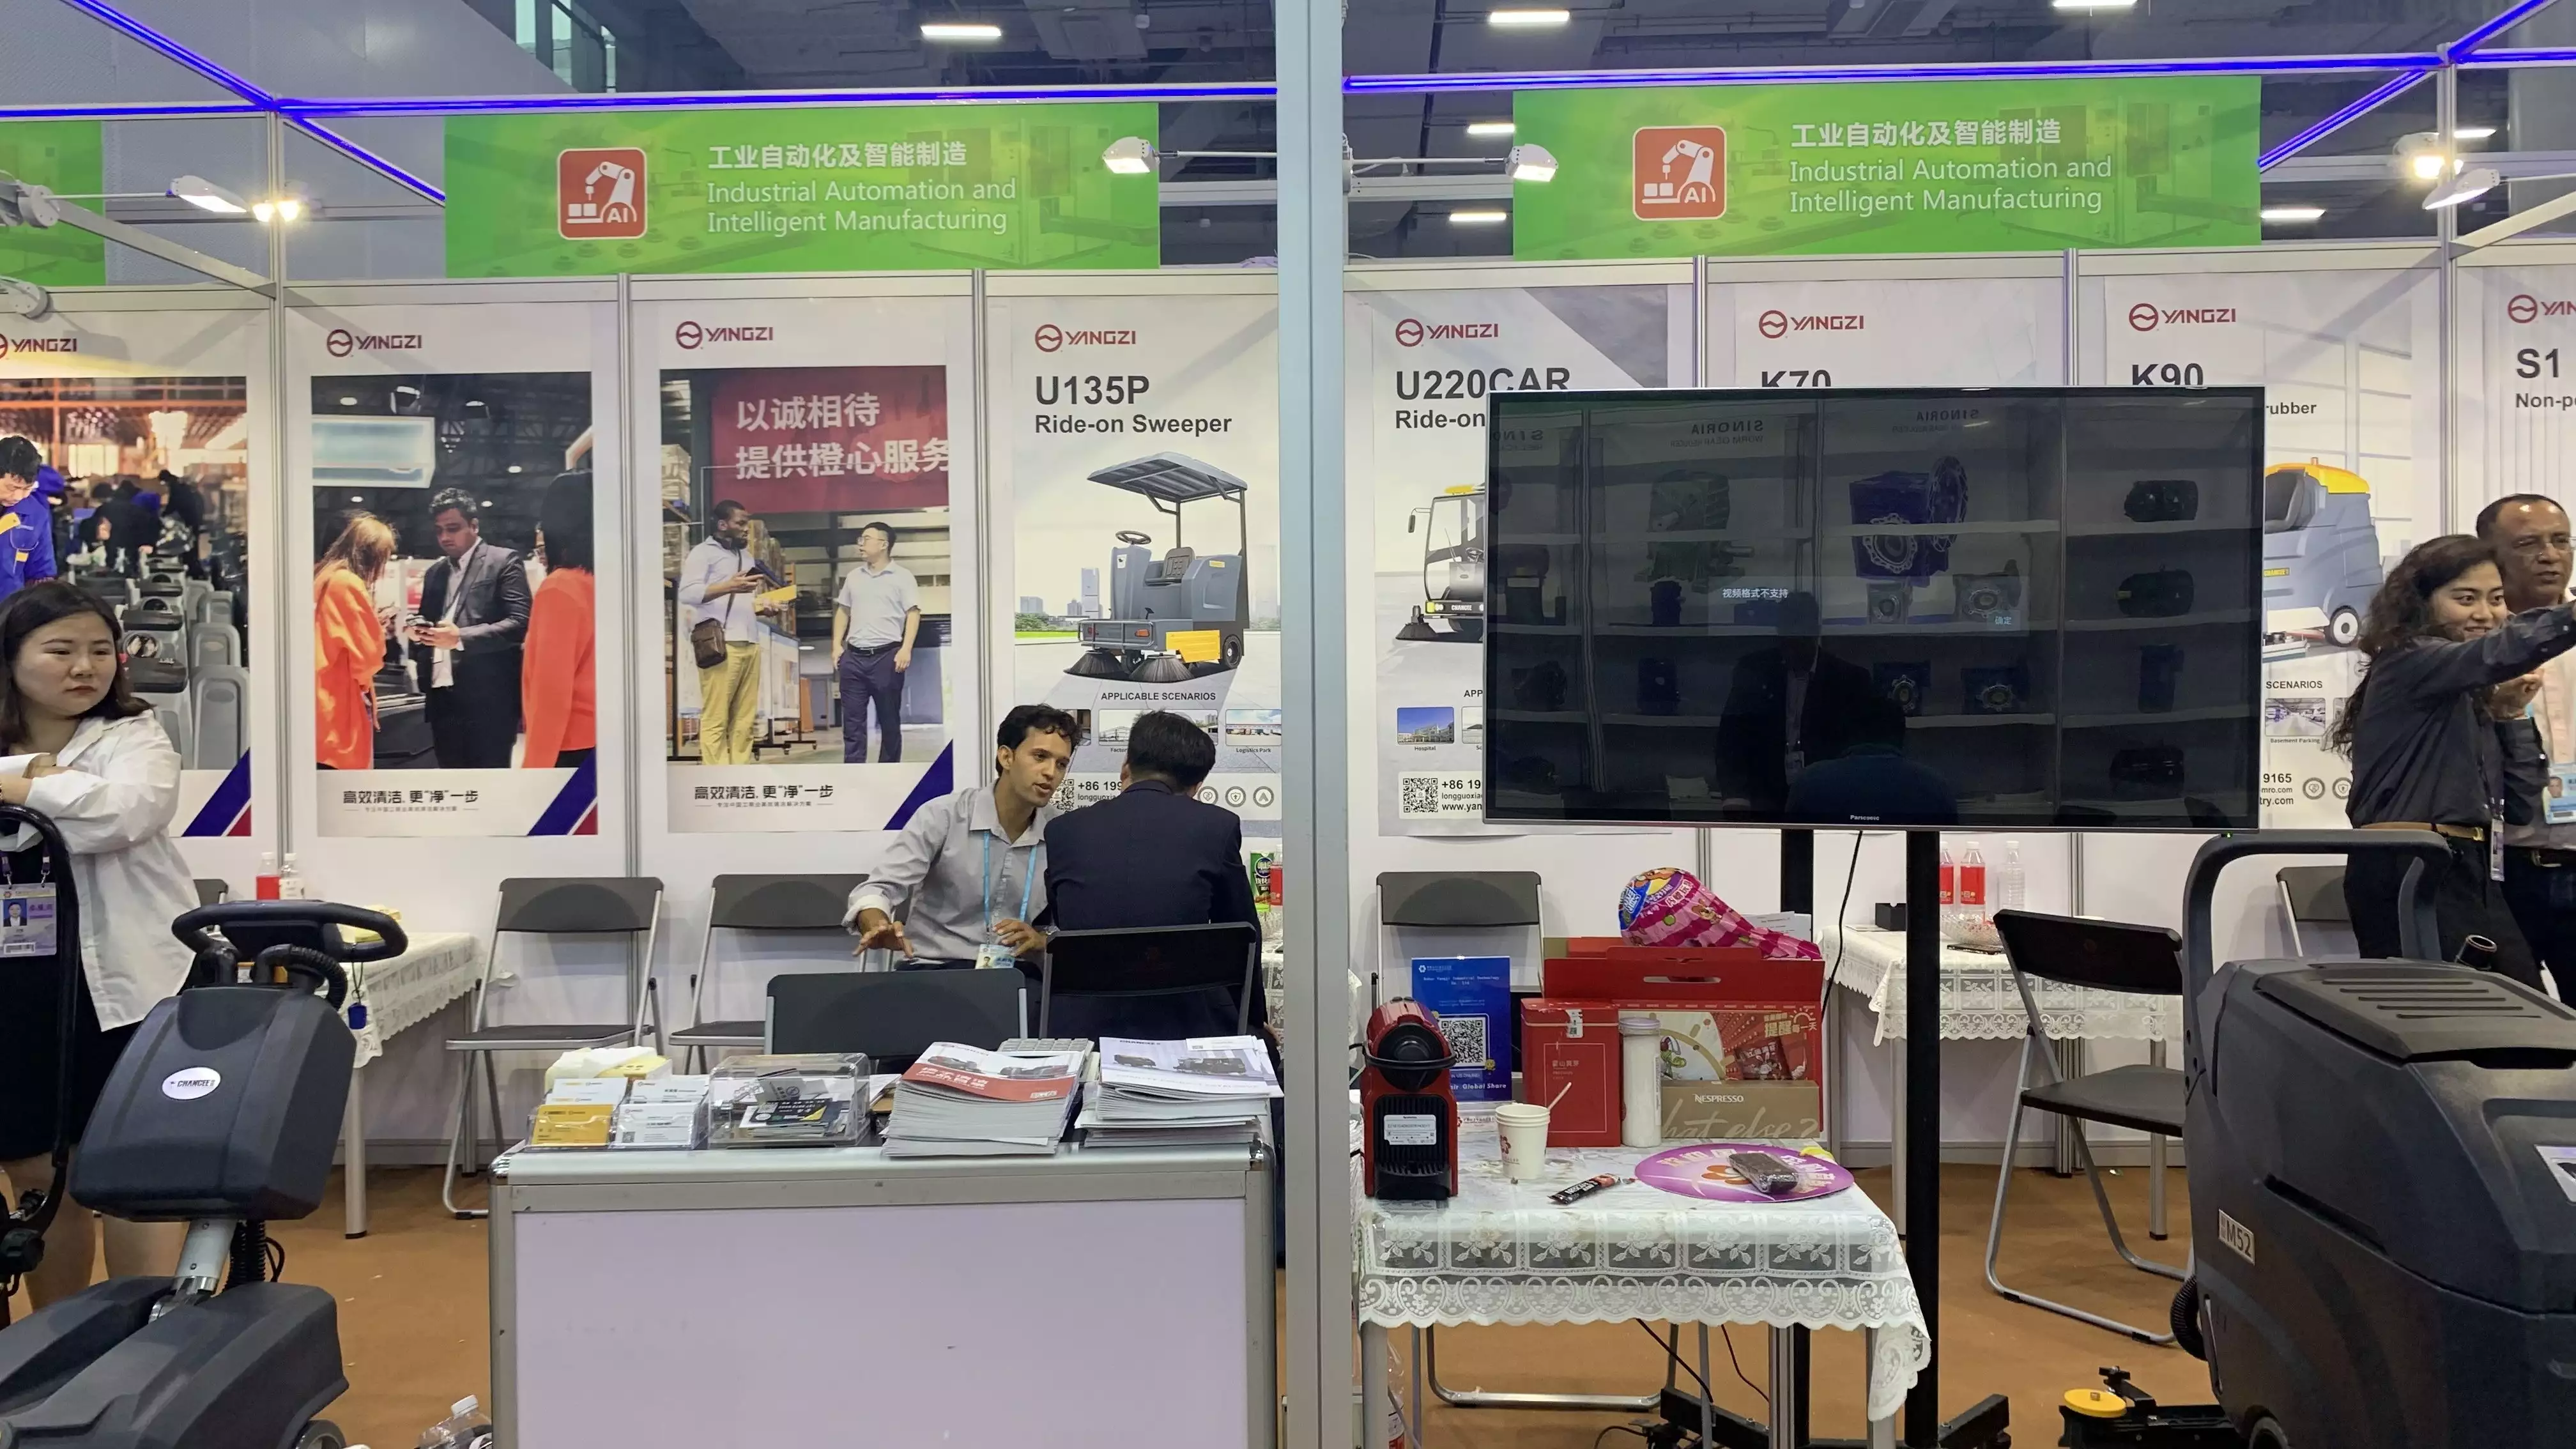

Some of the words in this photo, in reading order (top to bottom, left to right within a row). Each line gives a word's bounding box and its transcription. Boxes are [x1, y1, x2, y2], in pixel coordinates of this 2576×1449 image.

[1791, 119, 2061, 148] 工业自动化及智能制造
[709, 142, 967, 169] 工业自动化及智能制造
[1791, 160, 1904, 183] Industrial
[1913, 157, 2058, 180] Automation
[2067, 156, 2112, 178] and
[708, 183, 816, 204] Industrial
[825, 179, 964, 202] Automation
[973, 178, 1016, 199] and
[1685, 187, 1708, 203] AI
[1791, 190, 1913, 218] Intelligent
[1923, 188, 2101, 215] Manufacturing
[607, 208, 629, 222] AI
[708, 211, 827, 237] Intelligent
[834, 208, 1007, 234] Manufacturing
[1791, 316, 1864, 330] YANGZI
[2161, 308, 2236, 324] YANGZI
[705, 326, 773, 342] YANGZI
[1065, 330, 1136, 345] YANGZI
[1427, 323, 1498, 339] YANGZI
[11, 338, 77, 353] YANGZI
[355, 335, 422, 350] YANGZI
[1761, 369, 1831, 387] K70
[2132, 363, 2204, 385] K90
[1036, 375, 1149, 405] U135P
[1396, 367, 1570, 399] U220CAR
[736, 392, 880, 432] 以诚相待
[1395, 410, 1485, 428] Ride-on
[1035, 415, 1124, 433] Ride-on
[1132, 415, 1232, 437] Sweeper
[736, 437, 949, 480] 提供橙心服务
[1722, 588, 1788, 598] 视频格式不支持
[1101, 692, 1159, 701] APPLICABLE
[1162, 692, 1216, 701] SCENARIOS
[1078, 781, 1099, 791] +86
[1442, 780, 1464, 789] +86
[2263, 773, 2292, 783] 9165
[1693, 1093, 1744, 1104] NESPRESSO
[2227, 1220, 2251, 1257] M52
